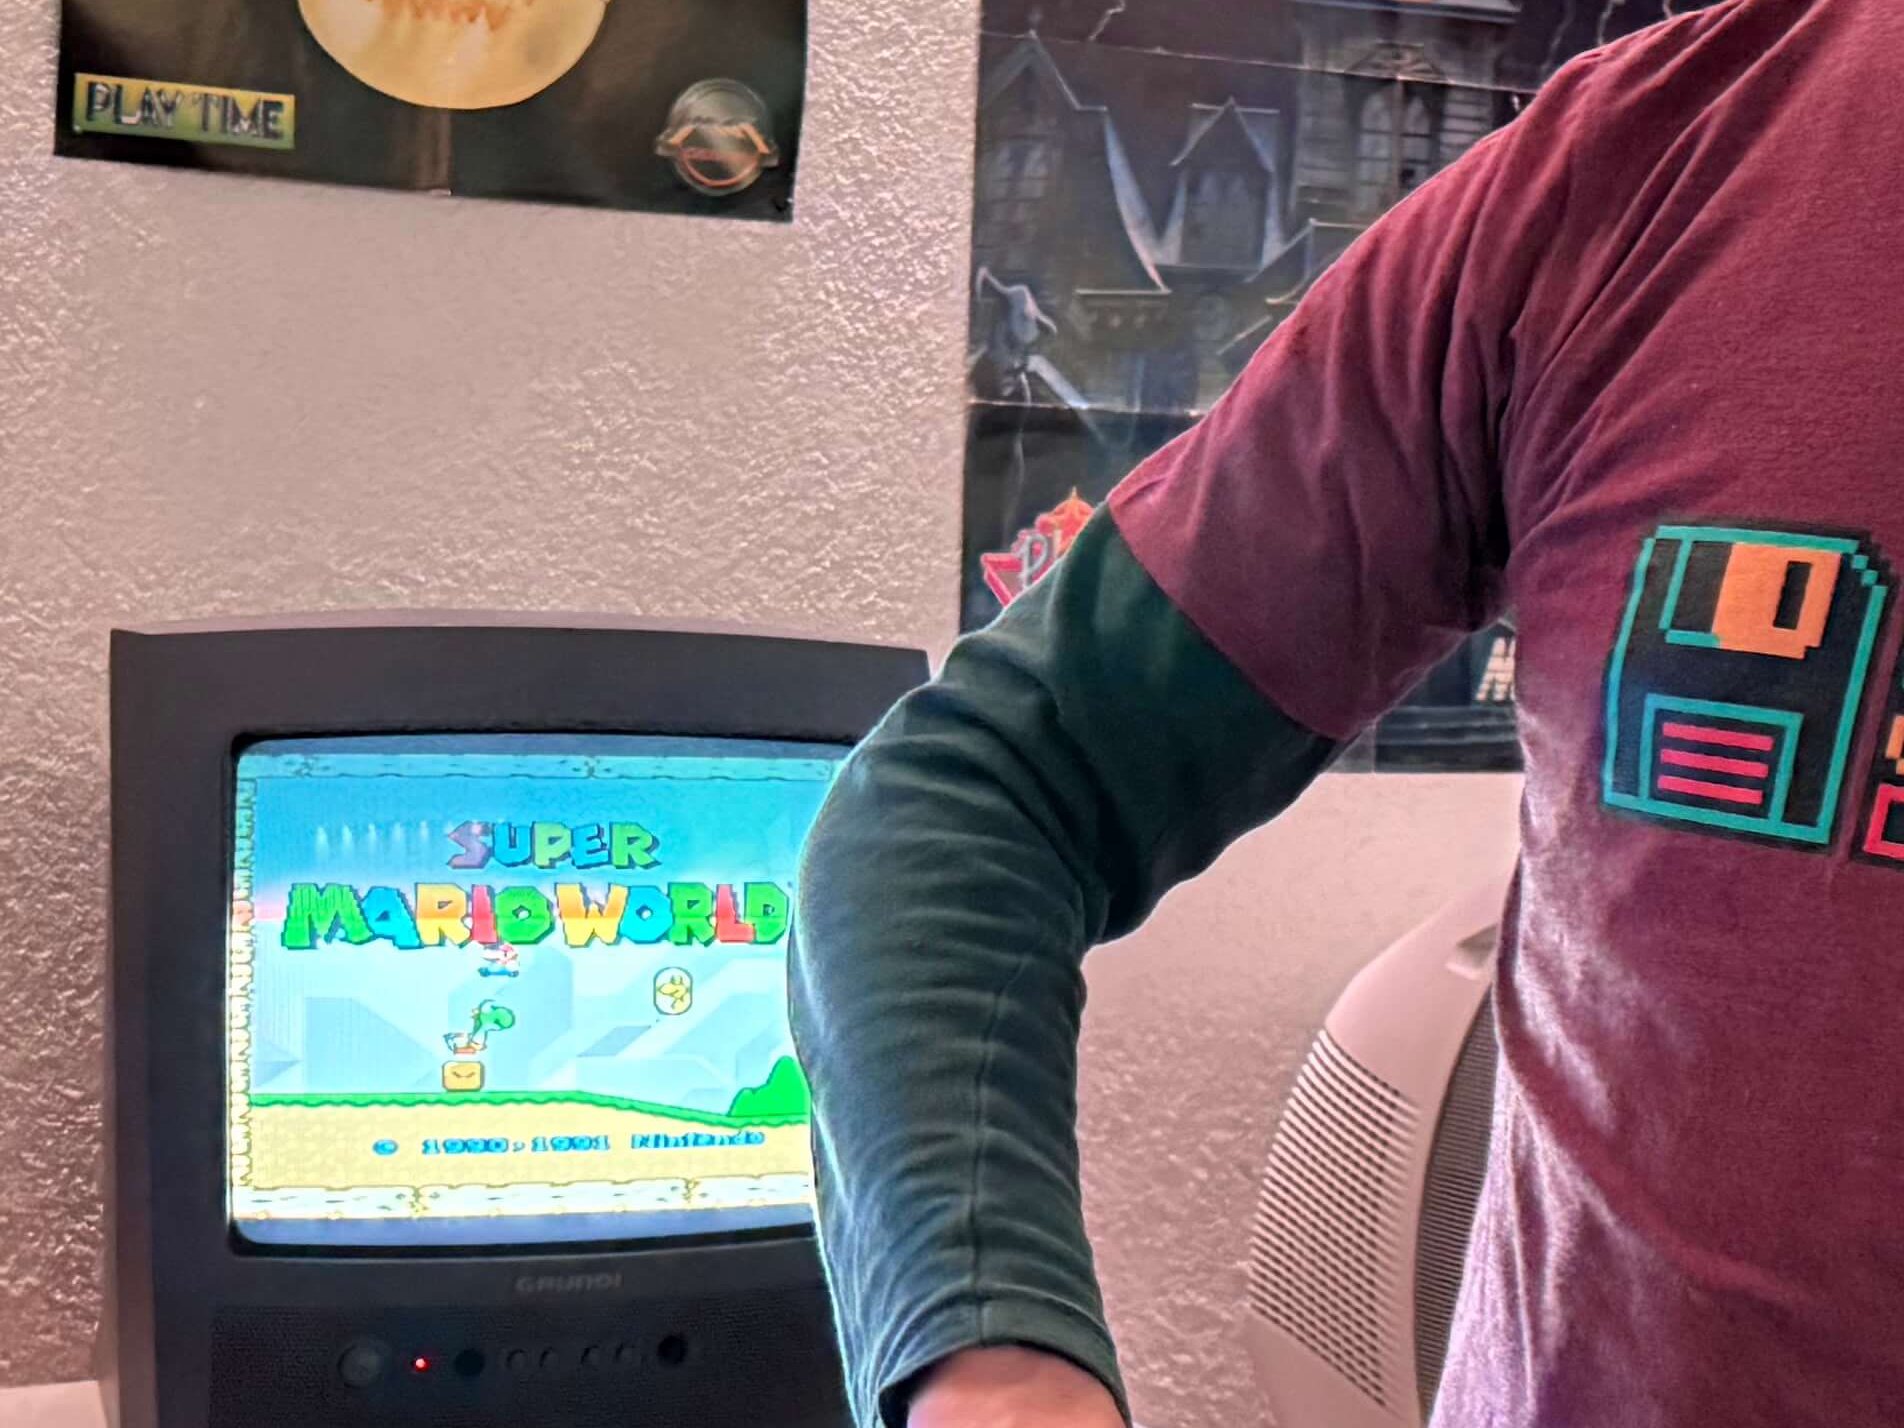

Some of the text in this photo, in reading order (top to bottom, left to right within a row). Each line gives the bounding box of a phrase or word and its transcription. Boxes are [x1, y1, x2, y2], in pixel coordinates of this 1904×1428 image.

[446, 821, 662, 869] SUPER
[281, 881, 791, 950] MARIO WORLD
